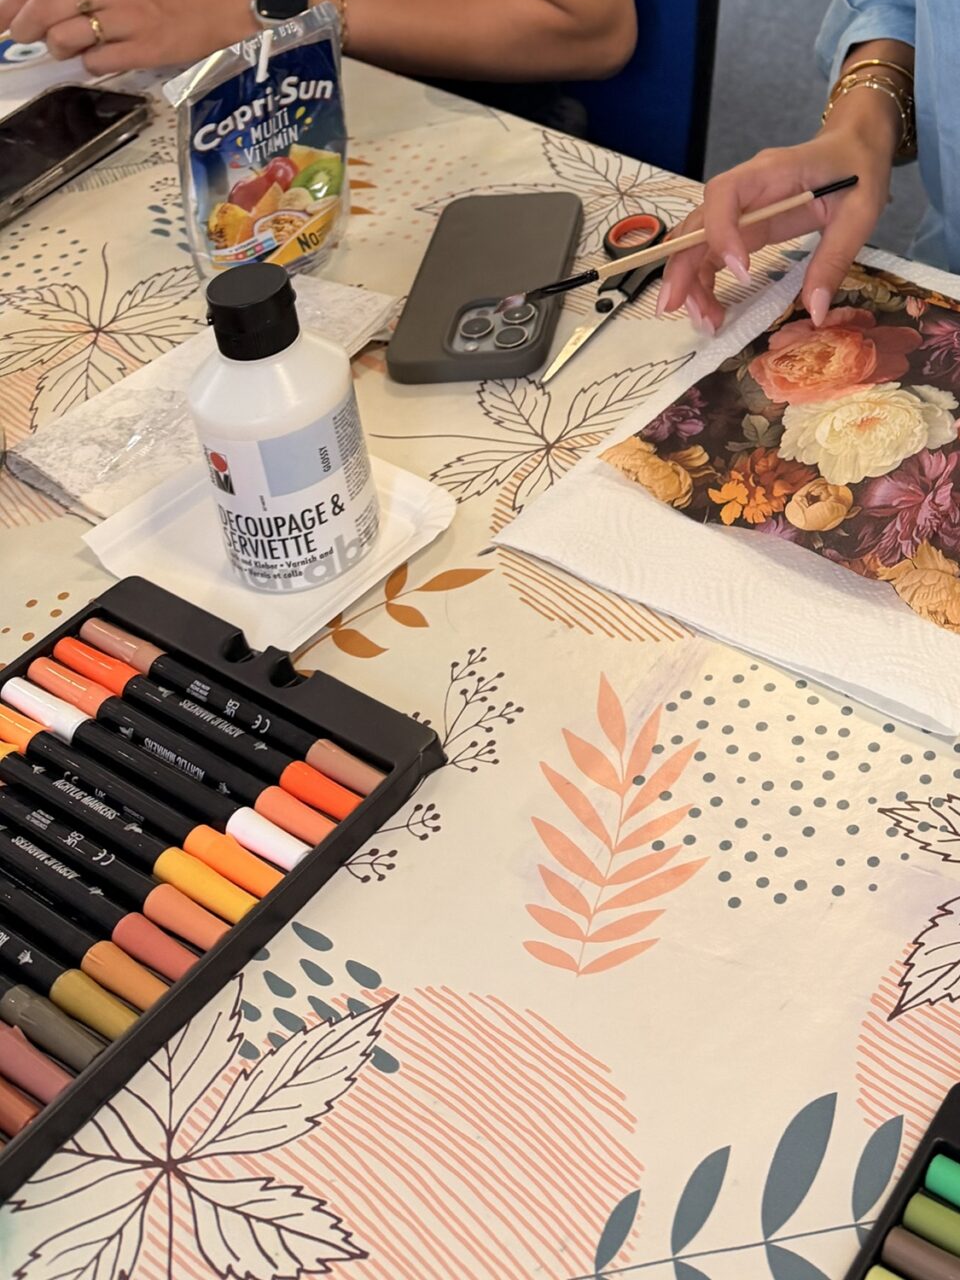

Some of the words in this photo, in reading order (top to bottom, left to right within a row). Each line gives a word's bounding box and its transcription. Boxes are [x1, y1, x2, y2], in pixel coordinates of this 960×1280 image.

[193, 76, 333, 151] Capri-Sun
[318, 446, 332, 473] GLOSSY
[218, 501, 328, 539] DECOUPAGE
[330, 493, 345, 516] &
[223, 526, 318, 560] SERVIETTE
[254, 561, 278, 570] Kleber
[285, 555, 317, 568] Varnish
[319, 546, 334, 560] and
[283, 570, 303, 579] colle
[178, 699, 217, 725] MARKERS
[212, 716, 245, 738] ACRYLIC
[144, 737, 178, 764] MARKERS
[175, 754, 205, 781] ACRYLIC
[52, 779, 88, 800] ACRYLIC
[81, 795, 120, 820] MARKERS
[11, 835, 50, 862] MARKERS
[44, 853, 80, 879] ACRYLIC
